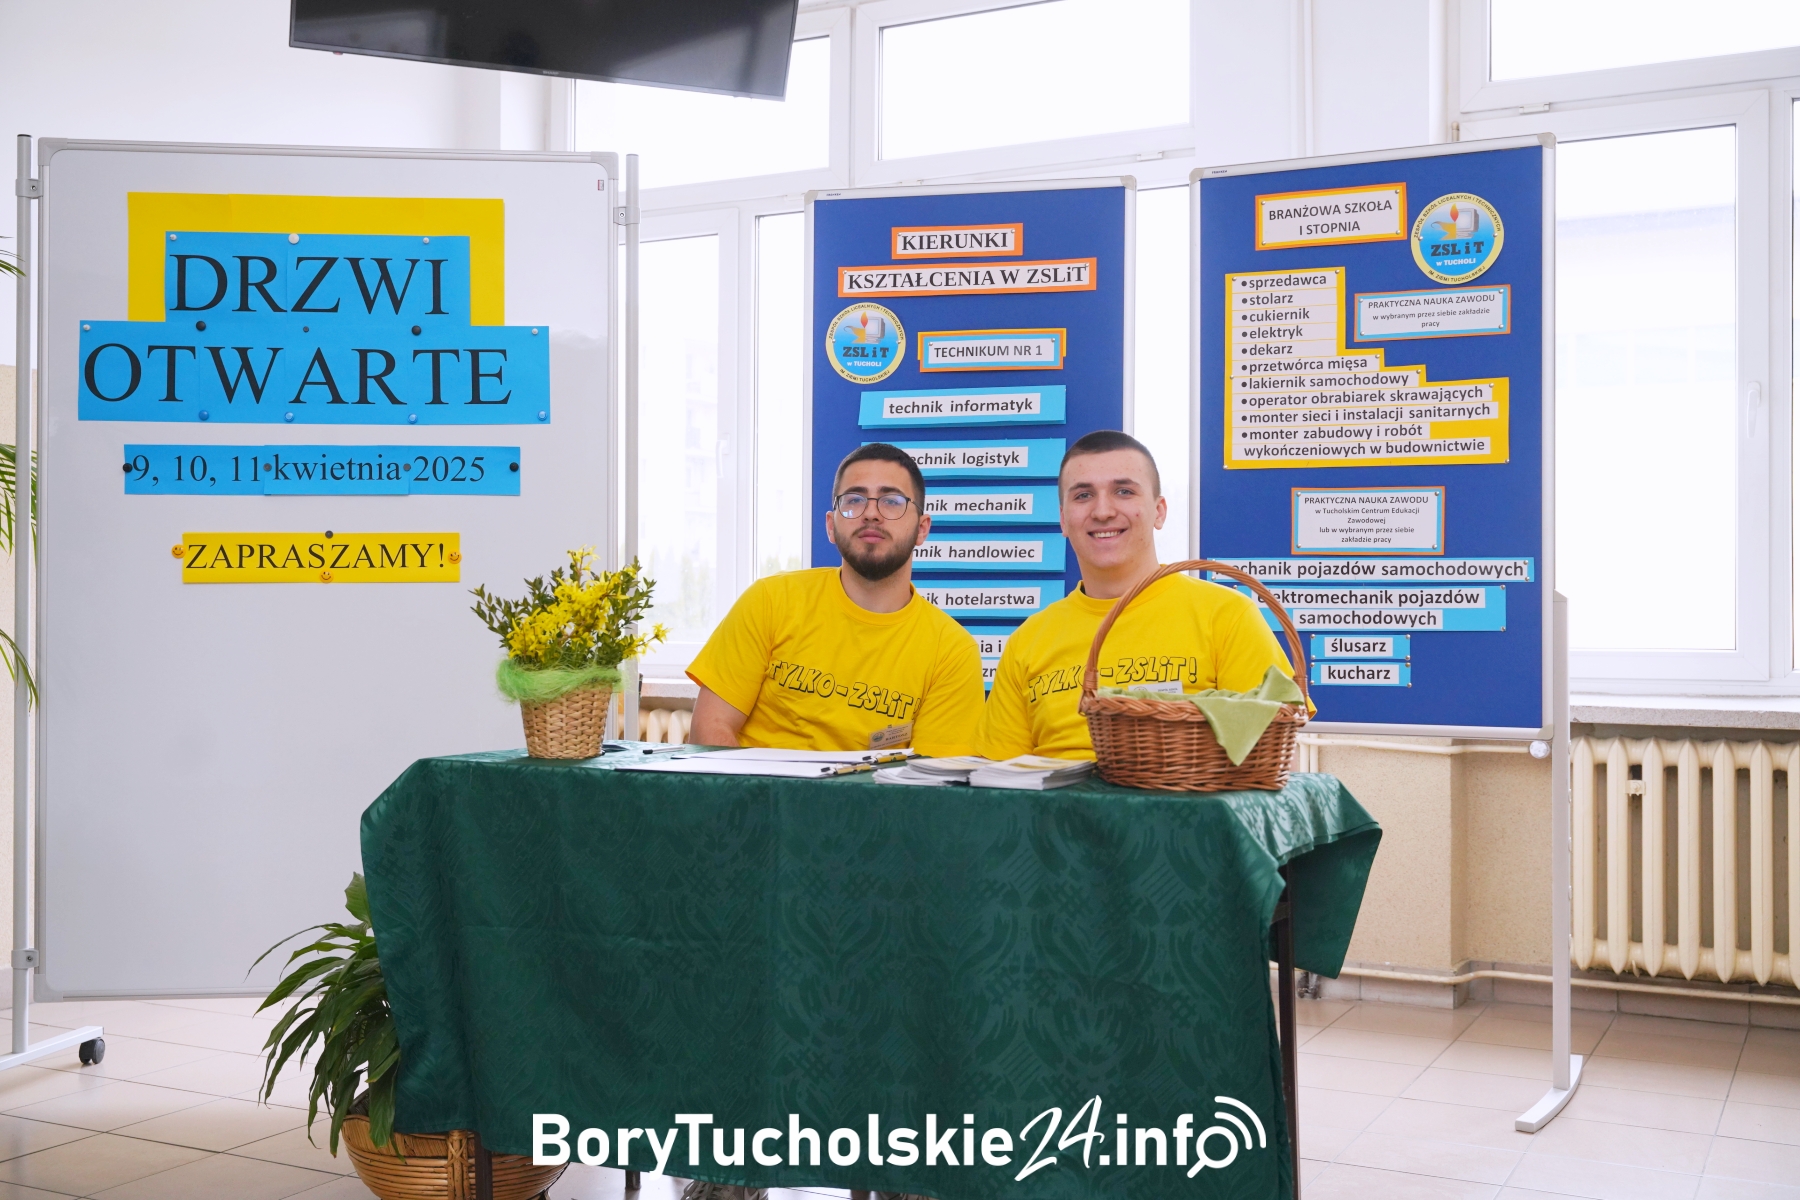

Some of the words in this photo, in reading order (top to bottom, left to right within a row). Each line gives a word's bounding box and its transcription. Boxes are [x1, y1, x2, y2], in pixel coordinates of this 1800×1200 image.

[1269, 204, 1341, 220] BRANŻOWA
[1345, 200, 1392, 214] SZKOŁA
[1299, 226, 1303, 235] I
[1306, 221, 1360, 235] STOPNIA
[902, 232, 1007, 250] KIERUNKI
[1431, 243, 1461, 257] ZSL
[1465, 242, 1470, 254] i
[1473, 241, 1484, 253] T
[1444, 258, 1476, 266] TUCHOLI
[169, 254, 449, 315] DRZWI
[848, 269, 995, 289] KSZTAŁCENIA
[1000, 269, 1019, 284] W
[1027, 265, 1087, 284] ZSLiT
[1249, 274, 1326, 290] sprzedawca
[1250, 293, 1293, 306] stolarz
[1368, 299, 1421, 309] PRAKTYCZNA
[1424, 297, 1454, 305] NAUKA
[1456, 294, 1495, 303] ZAWODU
[1250, 308, 1310, 322] cukiernik
[1250, 325, 1303, 339] elektryk
[842, 346, 869, 357] ZSL
[880, 347, 889, 358] T
[934, 346, 1009, 358] TECHNIKUM
[1014, 345, 1031, 356] NR
[1036, 345, 1042, 355] 1
[1249, 344, 1293, 356] dekarz
[84, 343, 511, 405] OTWARTE
[1250, 359, 1323, 375] przetwórca
[1328, 357, 1367, 371] mięsa
[1249, 376, 1306, 389] lakiernik
[1310, 373, 1409, 387] samochodowy
[1249, 395, 1307, 409] operator
[1311, 390, 1385, 404] obrabiarek
[1390, 386, 1483, 402] skrawających
[889, 400, 943, 414] technik
[950, 398, 1032, 413] informatyk
[1250, 412, 1298, 423] monter
[1302, 410, 1331, 422] sieci
[1335, 410, 1339, 420] i
[1343, 407, 1403, 421] instalacji
[1409, 403, 1490, 419] sanitarnych
[1250, 429, 1298, 440] monter
[1303, 426, 1373, 440] zabudowy
[1376, 426, 1380, 436] i
[1385, 424, 1422, 436] robót
[1244, 442, 1366, 459] wykończeniowych
[1370, 446, 1382, 454] w
[1386, 439, 1485, 454] budownictwie
[911, 452, 956, 465] echnik
[962, 451, 1020, 467] logistyk
[133, 456, 159, 485] 9,
[174, 455, 218, 486] 10,
[232, 456, 259, 481] 11
[273, 454, 401, 480] kwietnia
[413, 456, 484, 482] 2025
[954, 498, 1027, 511] mechanik
[1390, 496, 1428, 504] ZAWODU
[186, 543, 444, 568] ZAPRASZAMY!
[948, 545, 1035, 558] handlowiec
[1298, 561, 1376, 578] pojazdów
[1382, 561, 1523, 579] samochodowych
[945, 593, 1035, 606] hotelarstwa
[1258, 590, 1393, 605] eektromechanik
[1399, 589, 1479, 607] pojazdów
[1299, 610, 1436, 628] samochodowych
[1331, 638, 1386, 652] ślusarz
[1328, 665, 1390, 680] kucharz
